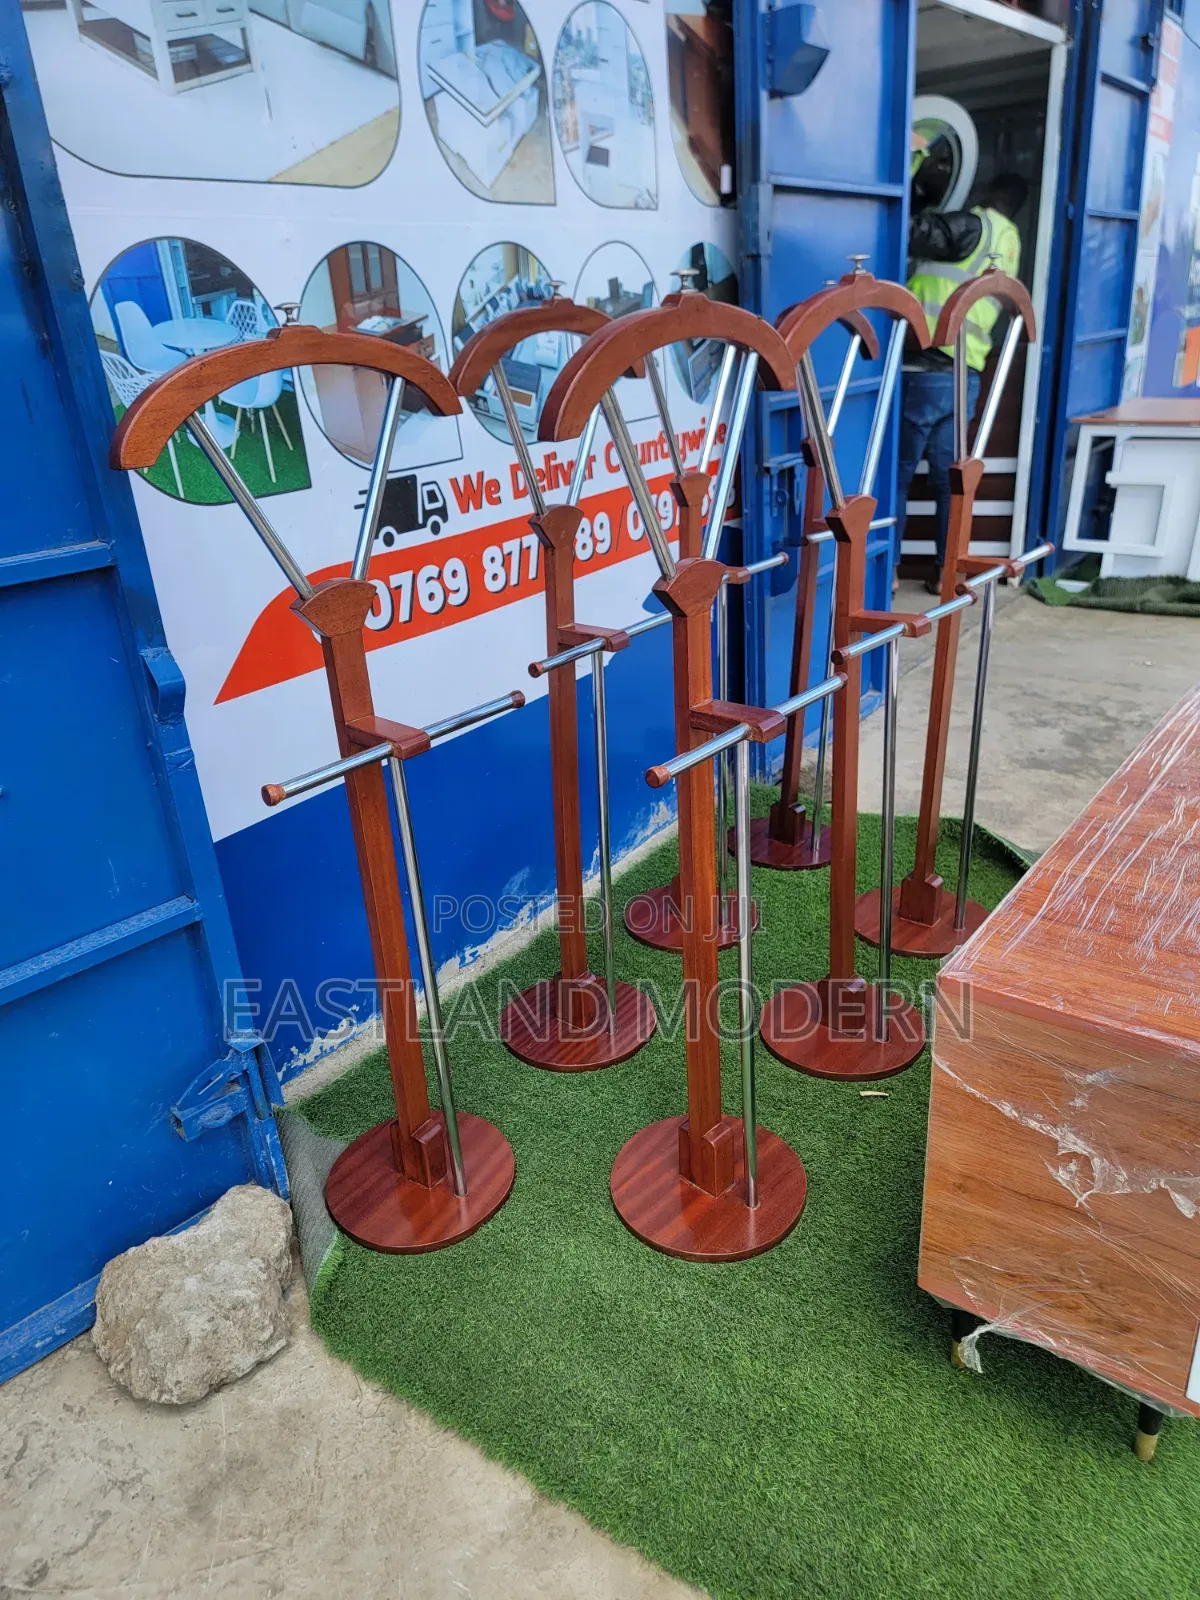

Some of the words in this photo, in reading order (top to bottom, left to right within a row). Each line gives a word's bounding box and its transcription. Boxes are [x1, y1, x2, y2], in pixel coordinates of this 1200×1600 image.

[448, 470, 502, 515] We
[364, 557, 469, 632] 0769
[482, 533, 540, 593] 877
